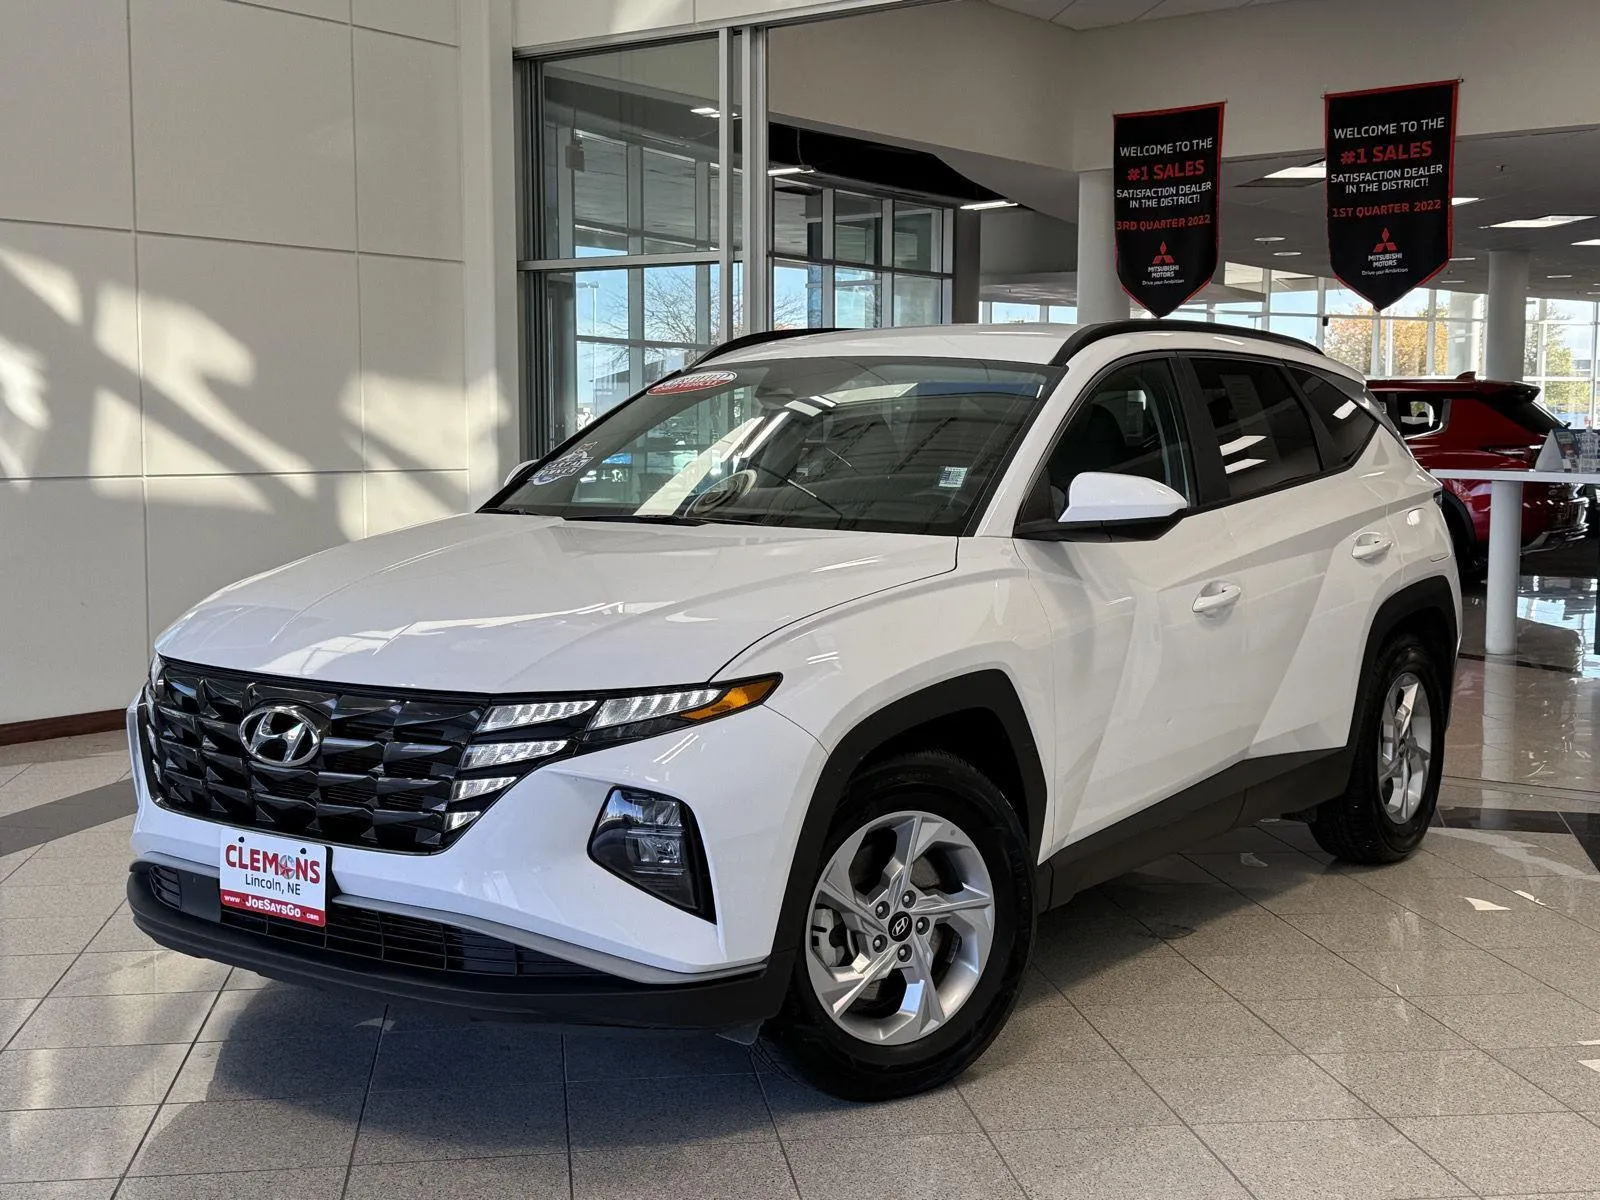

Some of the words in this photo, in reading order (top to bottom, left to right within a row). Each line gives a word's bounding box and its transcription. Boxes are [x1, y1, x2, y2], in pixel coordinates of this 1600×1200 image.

[1334, 123, 1397, 139] WELCOME
[1400, 121, 1418, 132] TO
[1420, 117, 1445, 131] THE
[1120, 143, 1173, 157] WELCOME
[1176, 141, 1190, 152] TO
[1192, 137, 1213, 150] THE
[1340, 148, 1368, 165] #1
[1372, 140, 1432, 162] SALES
[1128, 165, 1149, 181] #1
[1153, 160, 1205, 180] SALES
[1330, 168, 1401, 183] SATISFACTION
[1404, 164, 1443, 178] DEALER
[1116, 186, 1176, 198] SATISFACTION
[1178, 182, 1212, 194] DEALER
[1346, 184, 1356, 194] IN
[1359, 183, 1379, 192] THE
[1382, 178, 1429, 190] DISTRICT!
[1129, 200, 1139, 208] IN
[1141, 199, 1158, 208] THE
[1160, 194, 1200, 207] DISTRICT!
[1332, 207, 1354, 218] 1ST
[1356, 203, 1410, 218] QUARTER
[1414, 200, 1442, 212] 2022
[1116, 220, 1137, 230] 3RD
[1140, 218, 1186, 231] QUARTER
[1188, 214, 1210, 226] 2022
[1368, 252, 1402, 262] MITSUBISHI
[1372, 260, 1397, 268] MOTORS
[225, 844, 320, 884] CLEMONS
[245, 874, 285, 894] Lincoln,
[288, 881, 301, 896] NE
